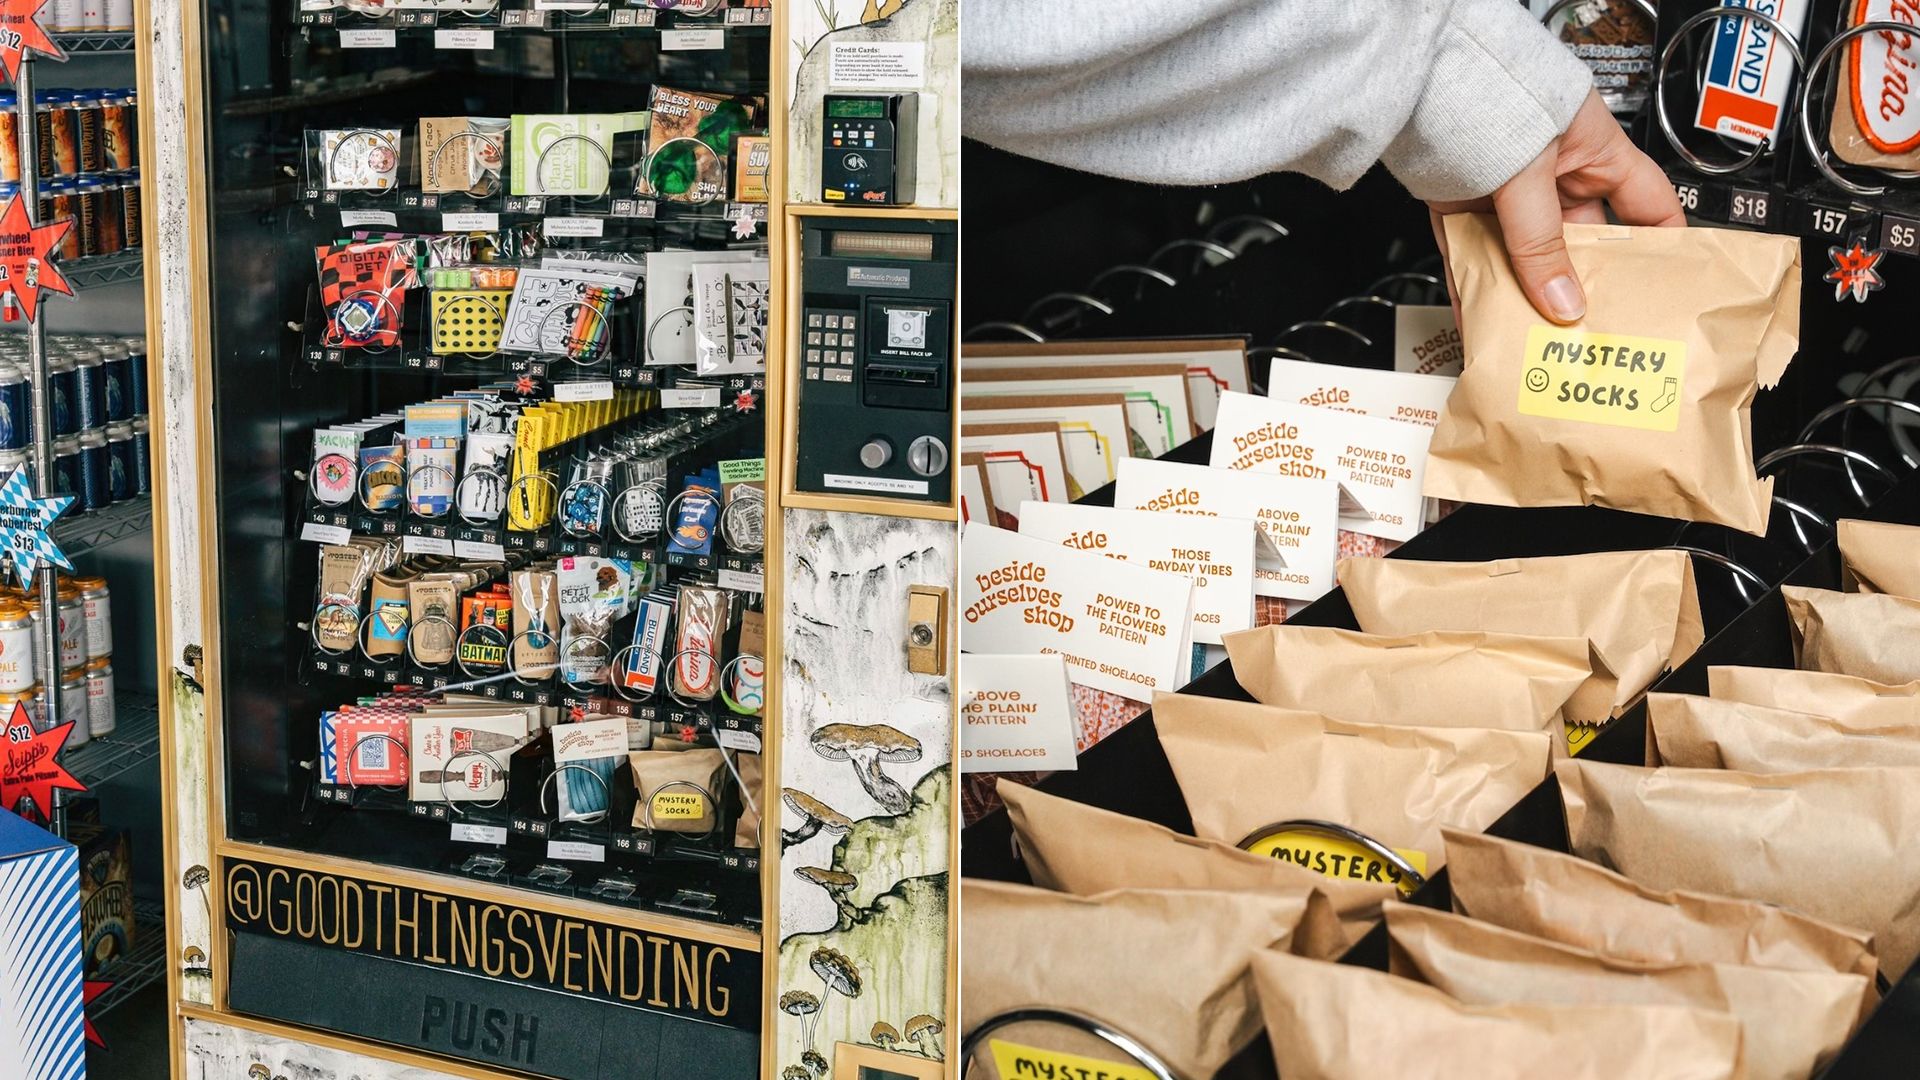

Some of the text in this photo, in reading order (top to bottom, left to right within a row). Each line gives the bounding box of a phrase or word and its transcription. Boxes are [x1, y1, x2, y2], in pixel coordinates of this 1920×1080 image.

[302, 15, 313, 23] 110
[320, 15, 332, 23] $15
[402, 14, 414, 22] 112
[660, 91, 718, 112] BLESS YOUR
[656, 102, 689, 117] HEART
[425, 150, 435, 186] Wonky
[306, 190, 317, 198] 120
[1672, 184, 1698, 210] 56
[508, 201, 520, 209] 124
[1733, 195, 1767, 219] $18
[1812, 208, 1847, 235] 157
[1890, 223, 1915, 247] $5
[355, 261, 383, 272] PET
[1542, 341, 1666, 373] MYSTERY
[512, 362, 525, 370] 134
[731, 379, 744, 387] 138
[1557, 381, 1639, 411] SOCKS
[1397, 406, 1438, 420] POWER
[1233, 422, 1298, 452] beside
[1346, 445, 1406, 465] POWER TO
[741, 460, 761, 470] Things
[1336, 456, 1412, 480] THE FLOWERS
[1350, 470, 1394, 488] PATTERN
[313, 514, 325, 523] 140
[1257, 508, 1300, 522] ABOVE
[433, 528, 446, 536] $15
[1272, 522, 1311, 537] PLAINS
[460, 531, 472, 539] 143
[483, 534, 495, 542] $15
[14, 534, 34, 551] $13
[511, 538, 523, 546] 144
[536, 540, 545, 548] $6
[589, 546, 598, 554] $6
[1172, 548, 1210, 561] THOSE
[671, 555, 683, 563] 147
[728, 560, 740, 568] 148
[1149, 560, 1232, 576] PAYDAY VIBES
[975, 560, 1046, 593] beside
[1255, 569, 1310, 585] SHOELACES
[561, 586, 590, 597] PETIT
[964, 584, 1062, 624] ourselves
[1096, 593, 1160, 620] POWER TO
[1023, 606, 1075, 634] shop
[1085, 604, 1167, 637] THE FLOWERS
[1099, 623, 1147, 646] PATTERN
[640, 619, 657, 675] BLUESBAND
[317, 662, 327, 670] 150
[340, 665, 347, 673] $7
[1061, 653, 1156, 687] PRINTED SHOELACES
[365, 669, 375, 677] 151
[387, 673, 396, 681] $5
[412, 676, 423, 685] 152
[487, 688, 495, 696] $5
[512, 691, 524, 699] 154
[538, 695, 546, 703] $5
[564, 698, 575, 706] 155
[588, 701, 600, 710] $10
[616, 706, 629, 714] 156
[989, 703, 1038, 714] PLAINS
[642, 709, 655, 717] $18
[670, 713, 684, 722] 157
[725, 720, 738, 728] 158
[967, 715, 1026, 726] PATTERN
[10, 725, 31, 742] $12
[977, 748, 1046, 759] SHOELACES
[469, 763, 483, 789] Happy
[320, 790, 331, 798] 160
[339, 791, 347, 799] $5
[658, 796, 697, 805] MYSTERY
[415, 806, 427, 814] 162
[665, 807, 690, 815] SOCKS
[514, 822, 526, 830] 164
[531, 823, 545, 833] $15
[617, 839, 629, 848] 166
[638, 841, 647, 850] $7
[725, 858, 738, 866] 168
[748, 860, 757, 868] $7
[1270, 846, 1402, 884] MYSTERY
[227, 863, 731, 1018] @GOODTHINGSVENDING
[420, 993, 539, 1065] PUSH
